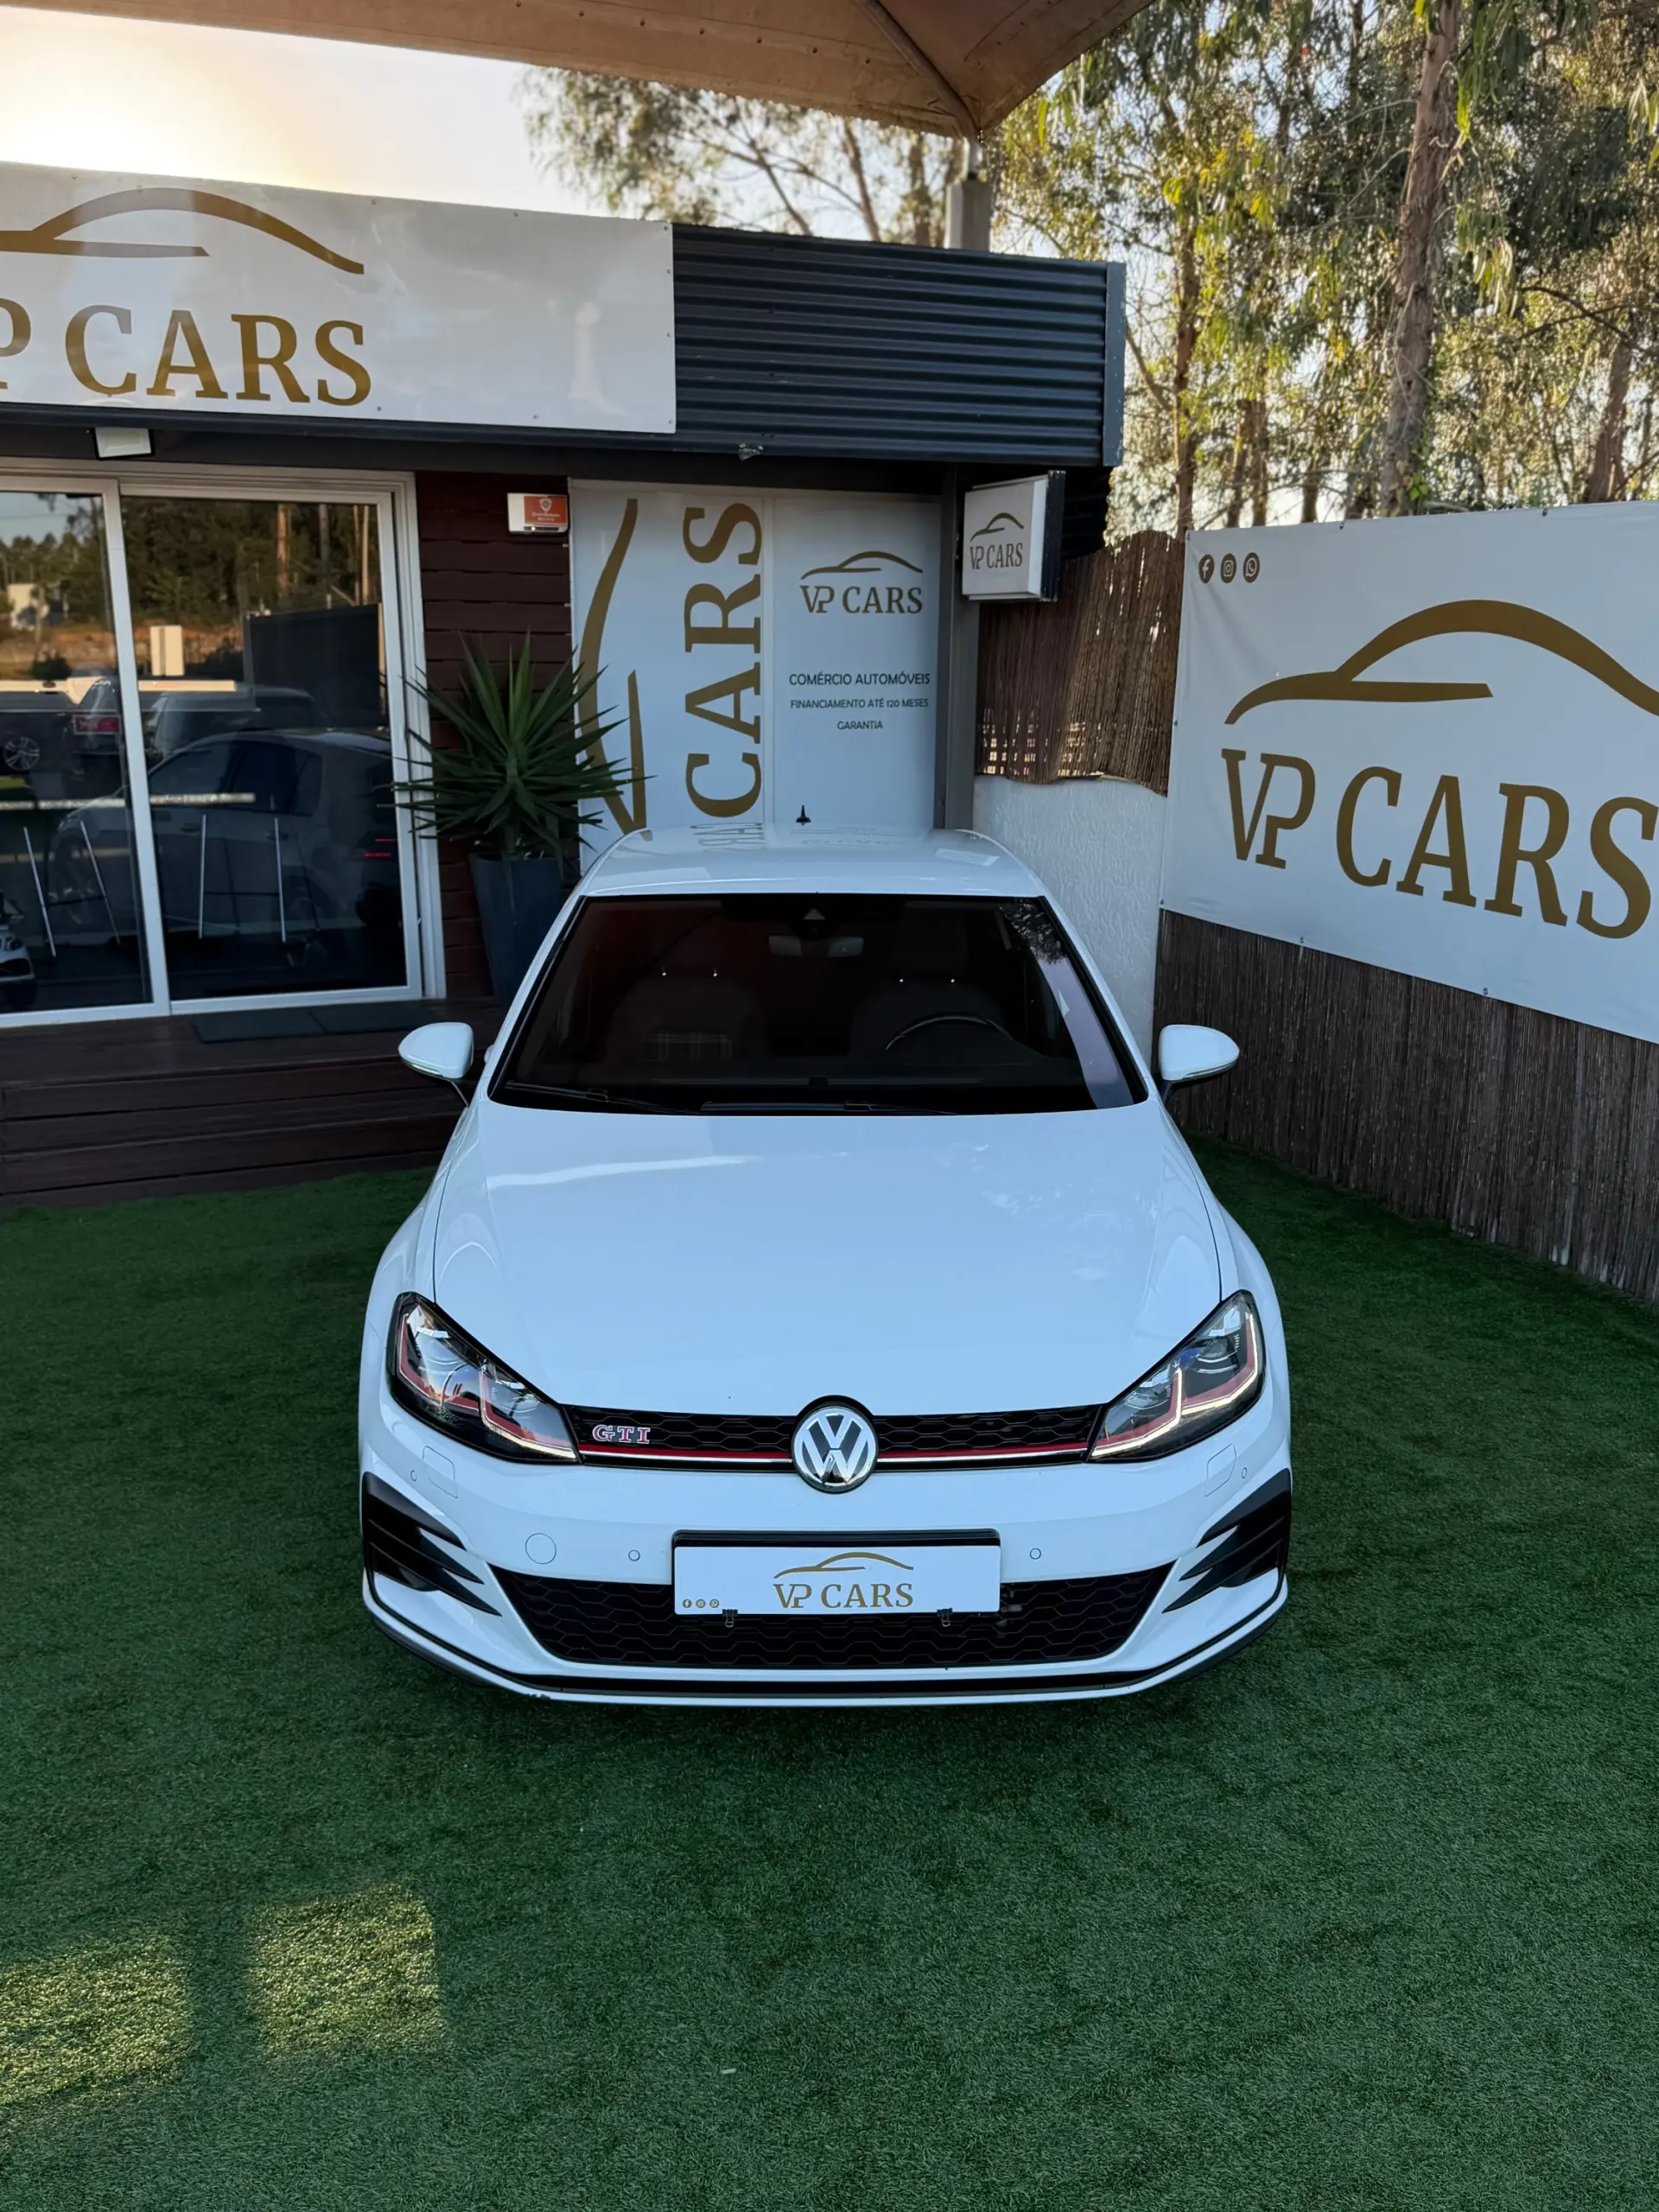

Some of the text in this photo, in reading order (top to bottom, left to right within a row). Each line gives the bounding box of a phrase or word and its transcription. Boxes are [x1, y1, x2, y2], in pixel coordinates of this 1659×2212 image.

[65, 304, 372, 406] CARS
[969, 542, 1023, 569] VP CARS
[799, 585, 923, 614] VP CARS
[683, 503, 762, 817] CARS
[789, 671, 931, 685] COMÉRCIO AUTOMÓVEIS
[791, 697, 929, 709] FINANCIAMENTO ATÉ 120 MESES
[837, 721, 883, 730] GARANTIA
[1221, 748, 1659, 939] VP CARS
[592, 1424, 651, 1444] GTI
[793, 1406, 876, 1487] VW
[772, 1582, 913, 1608] VP CARS
